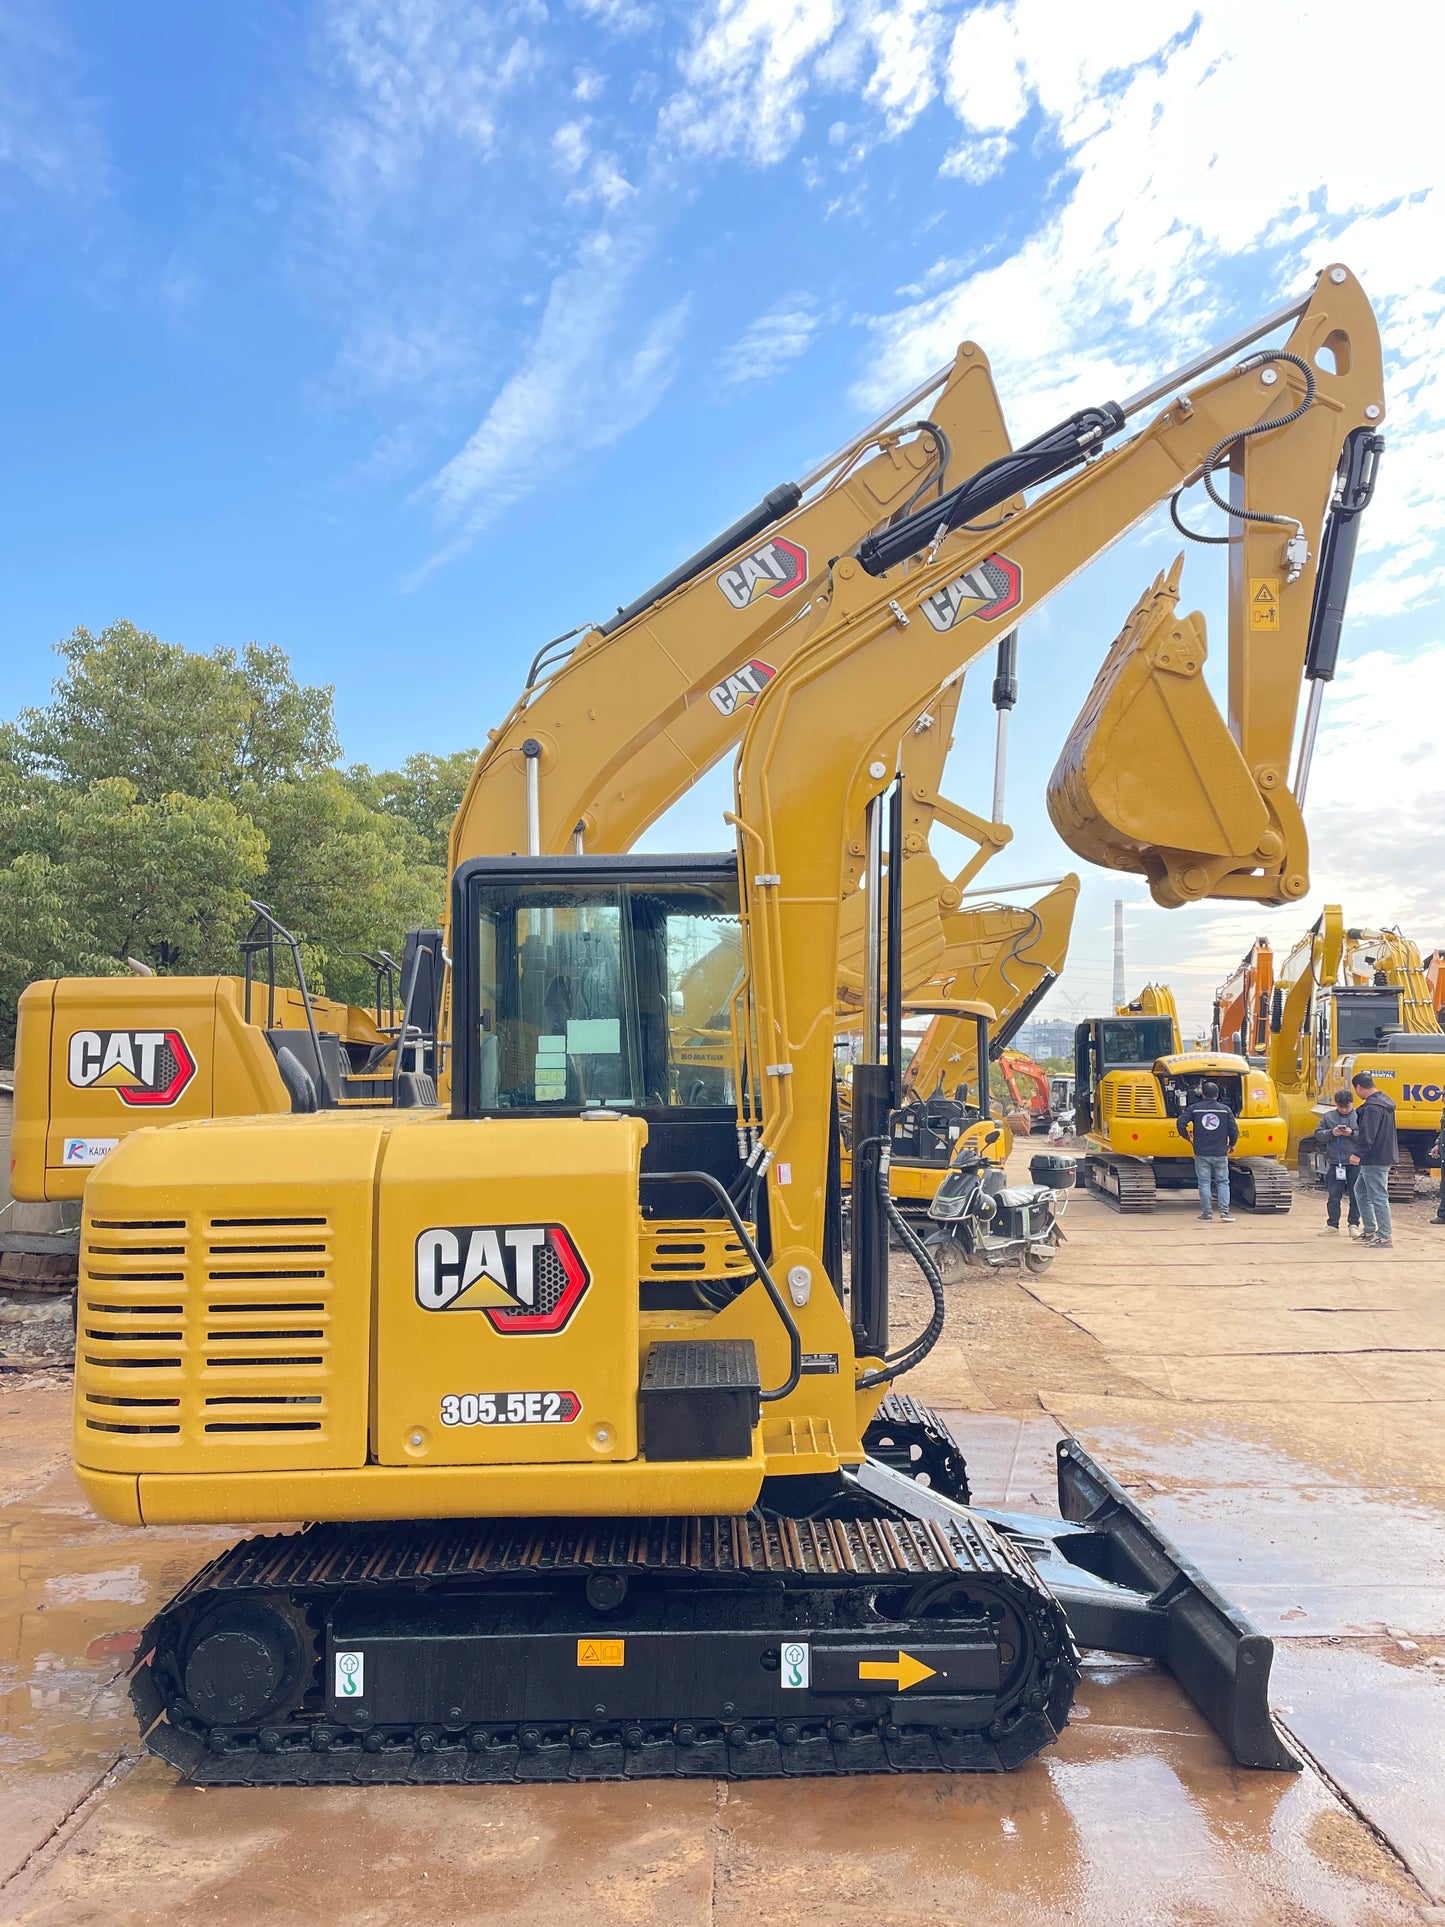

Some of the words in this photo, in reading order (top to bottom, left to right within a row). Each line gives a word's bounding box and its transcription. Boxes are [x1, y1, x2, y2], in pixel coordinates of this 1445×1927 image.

[718, 543, 787, 609] CAT
[920, 562, 998, 632] CAT
[709, 665, 763, 715] CAT
[70, 1031, 165, 1087] CAT
[681, 1053, 724, 1061] KOMATSU
[1403, 1084, 1445, 1102] KO
[417, 1228, 545, 1309] CAT
[442, 1392, 562, 1425] 305.5E2
